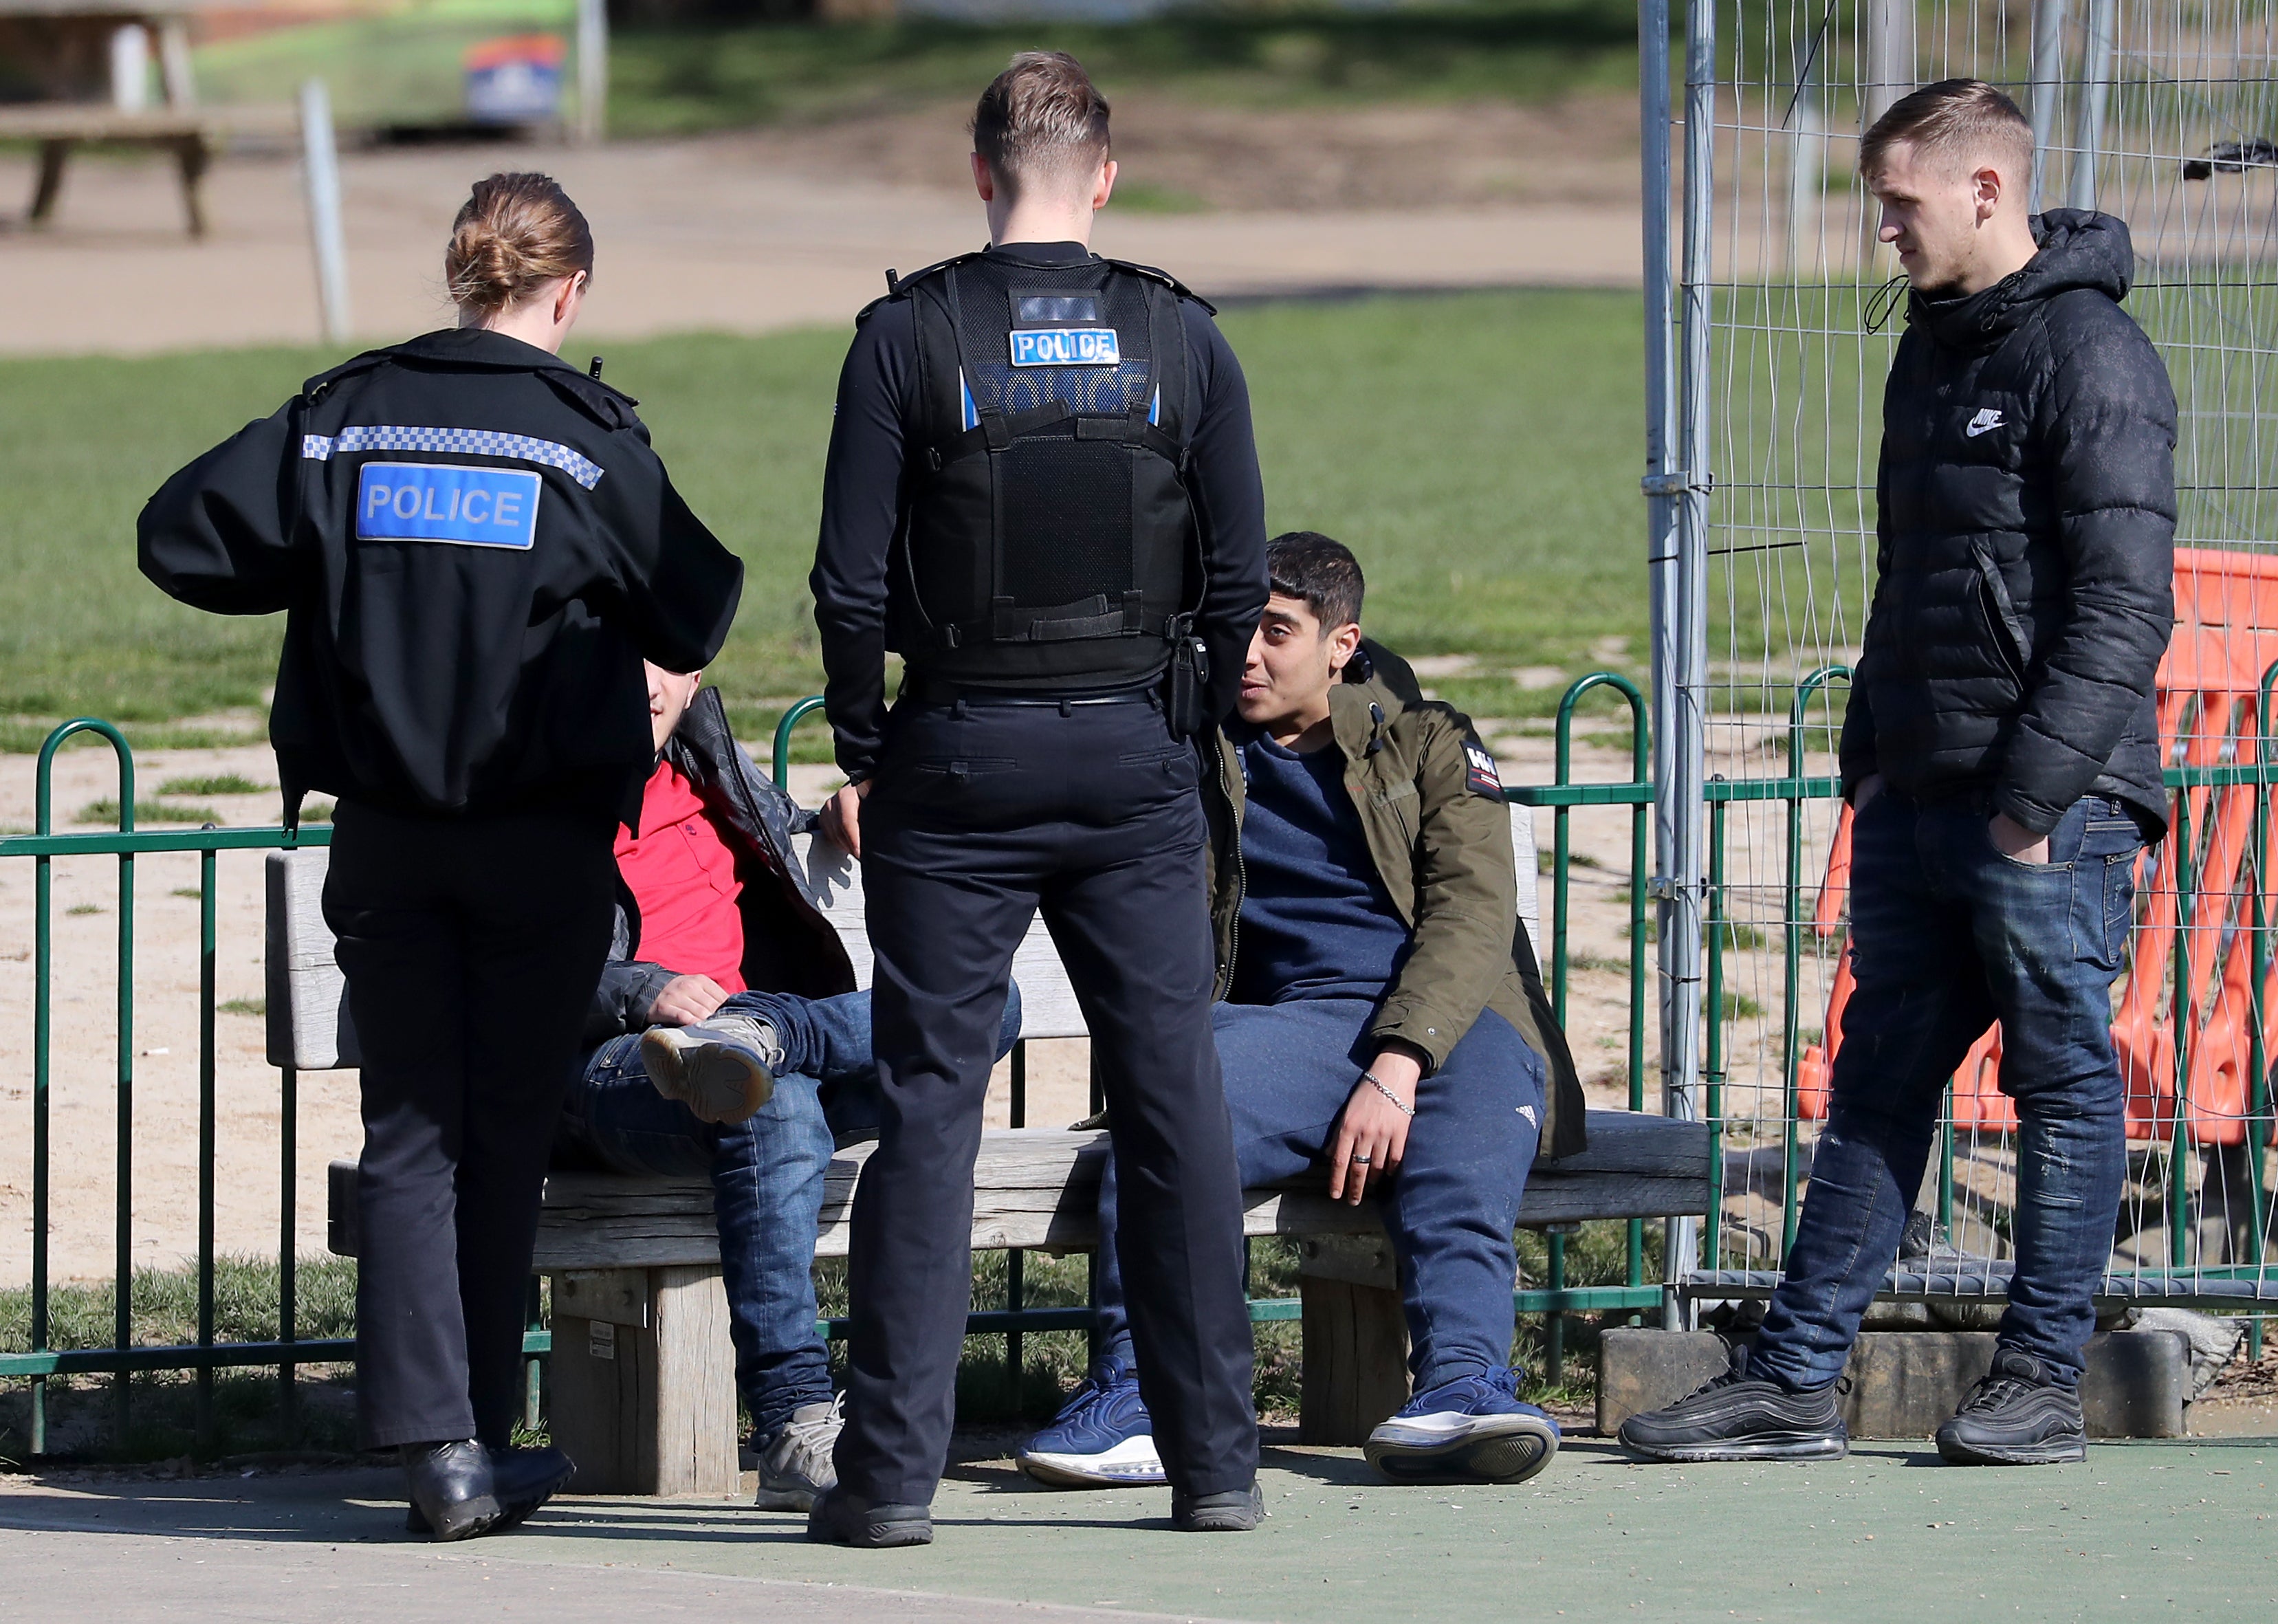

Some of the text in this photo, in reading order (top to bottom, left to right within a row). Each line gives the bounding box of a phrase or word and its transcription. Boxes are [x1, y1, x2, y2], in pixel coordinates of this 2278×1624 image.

[1018, 335, 1110, 360] POLICE
[1973, 408, 2002, 425] NIKE
[367, 485, 522, 526] POLICE
[1467, 748, 1496, 776] HH
